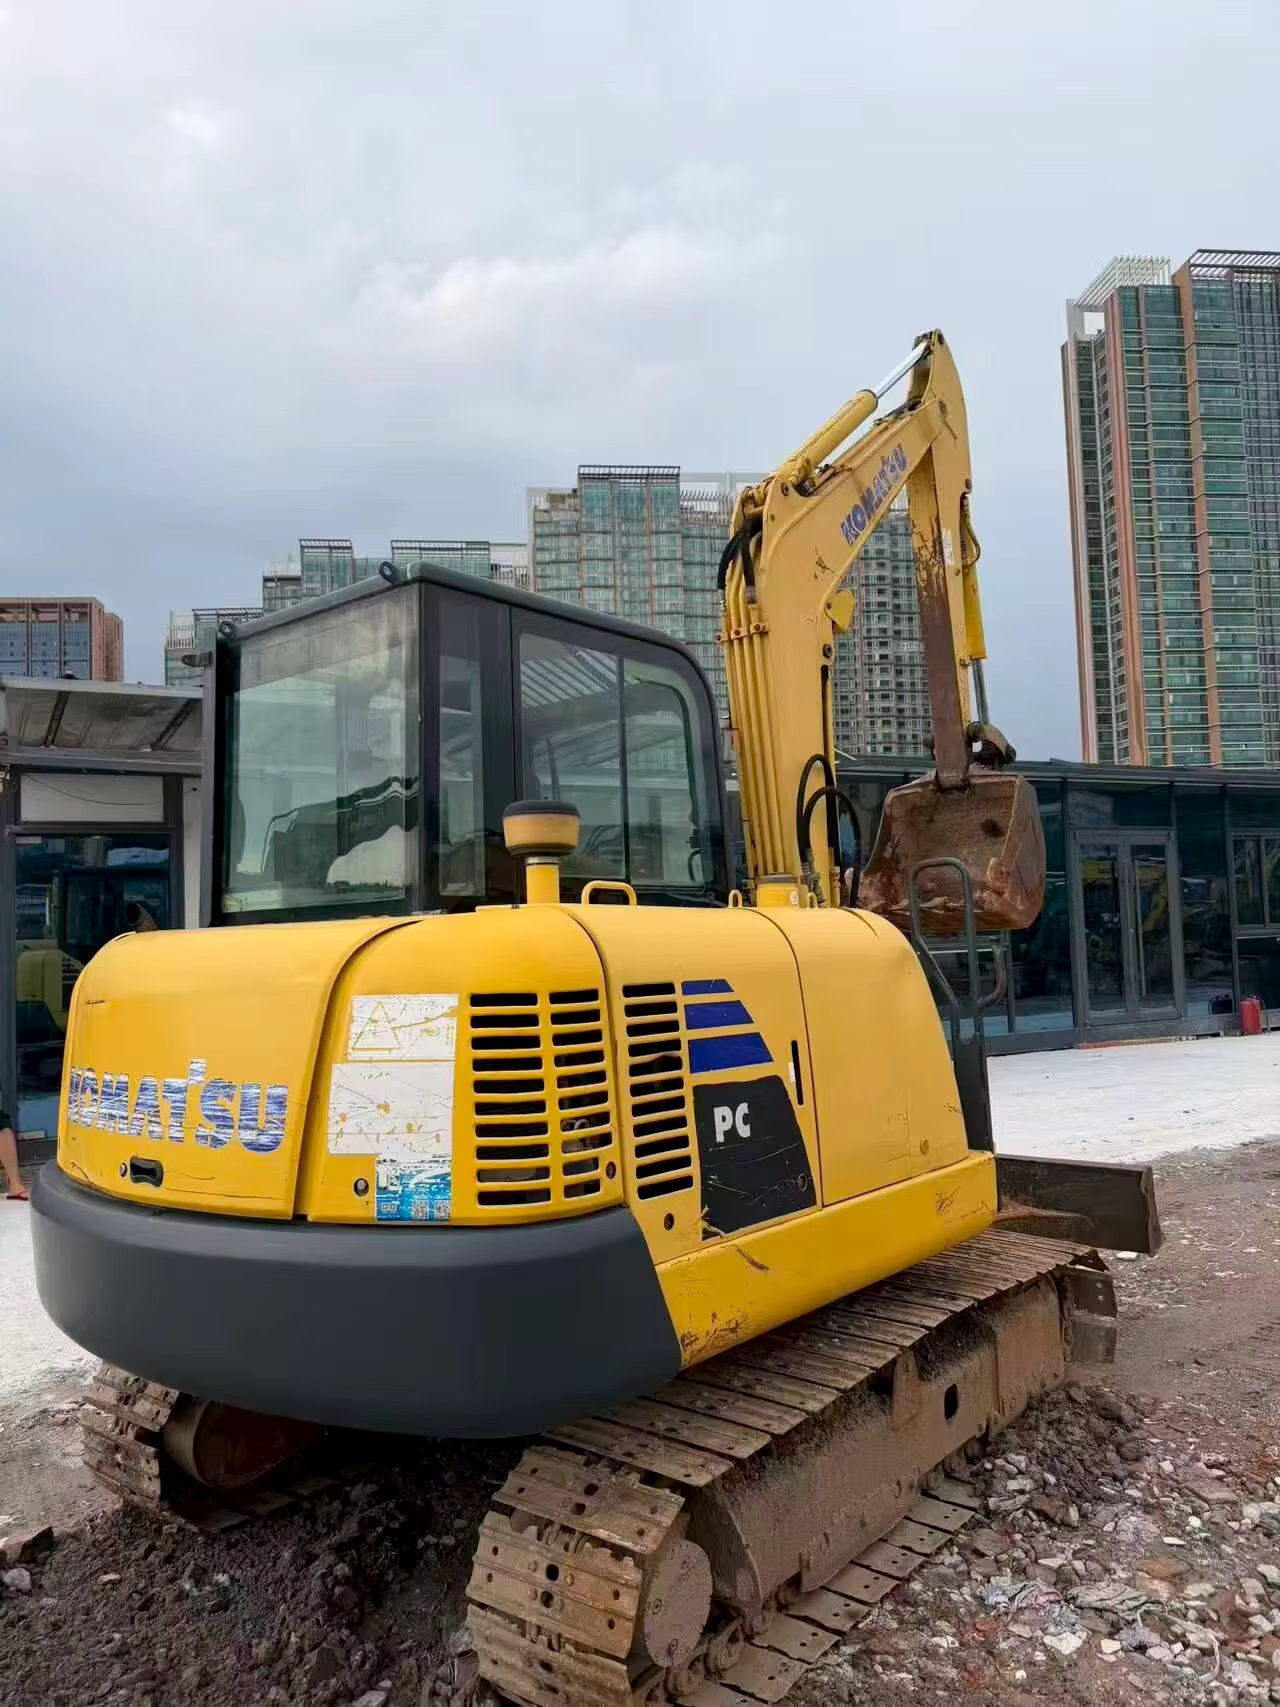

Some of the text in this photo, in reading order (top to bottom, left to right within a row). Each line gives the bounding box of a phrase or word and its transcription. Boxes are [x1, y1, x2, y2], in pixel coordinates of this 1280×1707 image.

[841, 443, 907, 546] KOMATSU
[68, 1058, 288, 1153] KOMATSU
[713, 1102, 751, 1143] PC
